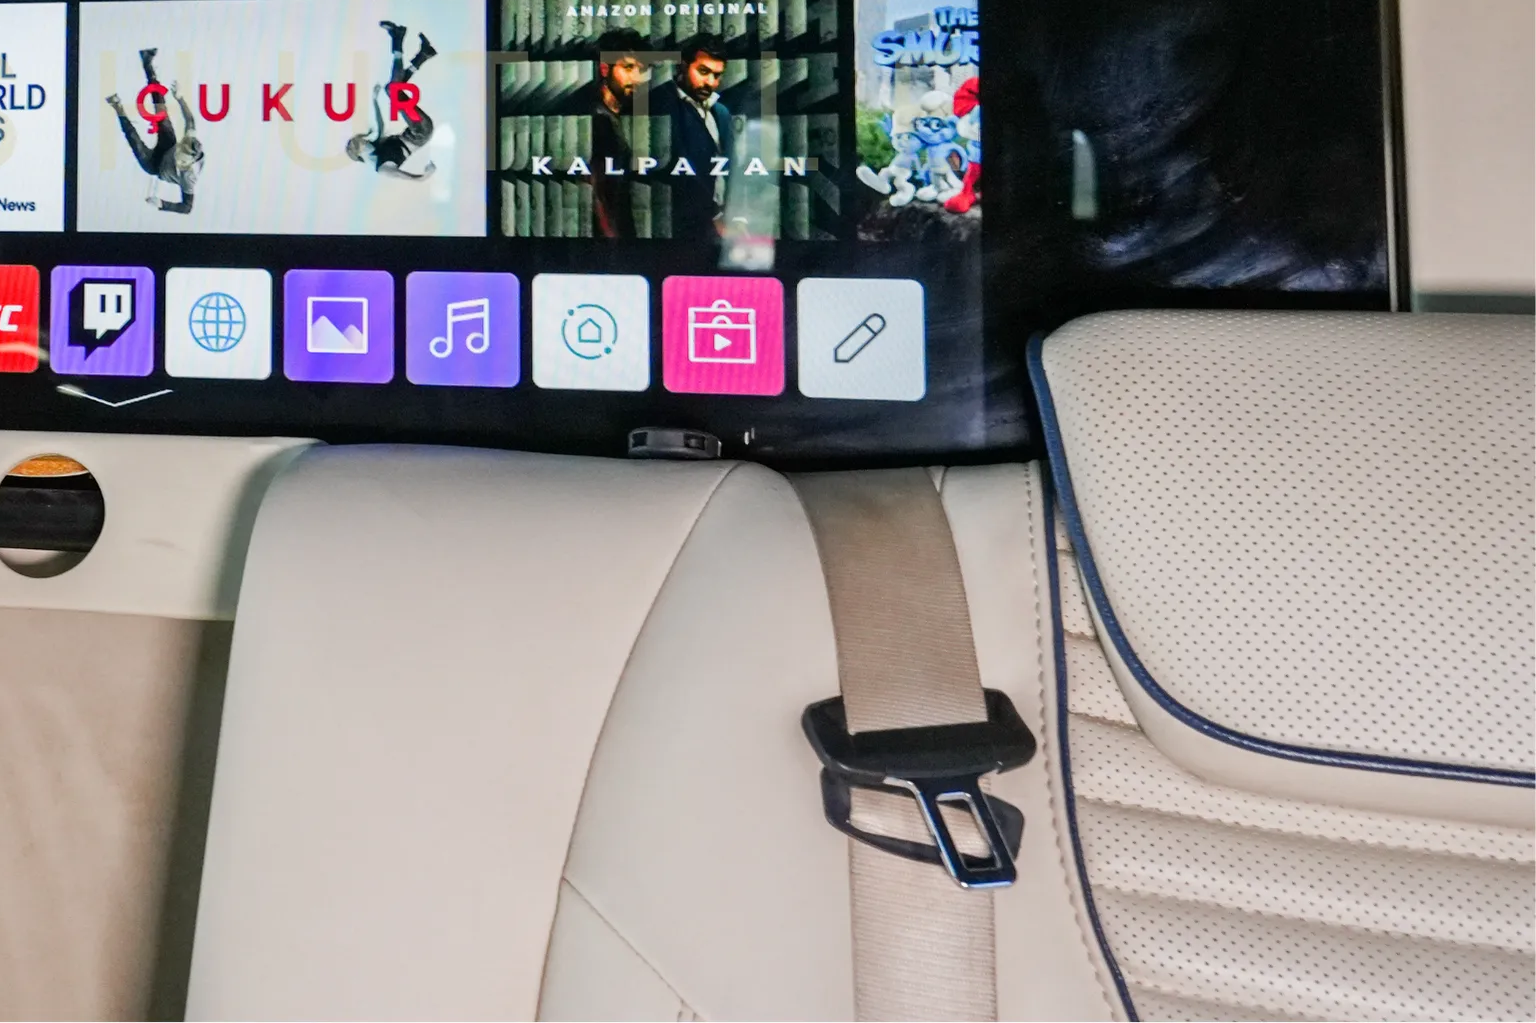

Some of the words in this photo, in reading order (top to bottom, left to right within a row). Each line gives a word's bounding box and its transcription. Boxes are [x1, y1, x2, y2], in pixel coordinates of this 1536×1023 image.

[566, 4, 653, 18] AMAZON
[663, 2, 769, 17] ORIGINAL
[136, 81, 425, 134] ÇUKUR
[531, 155, 807, 176] KALPAZAN
